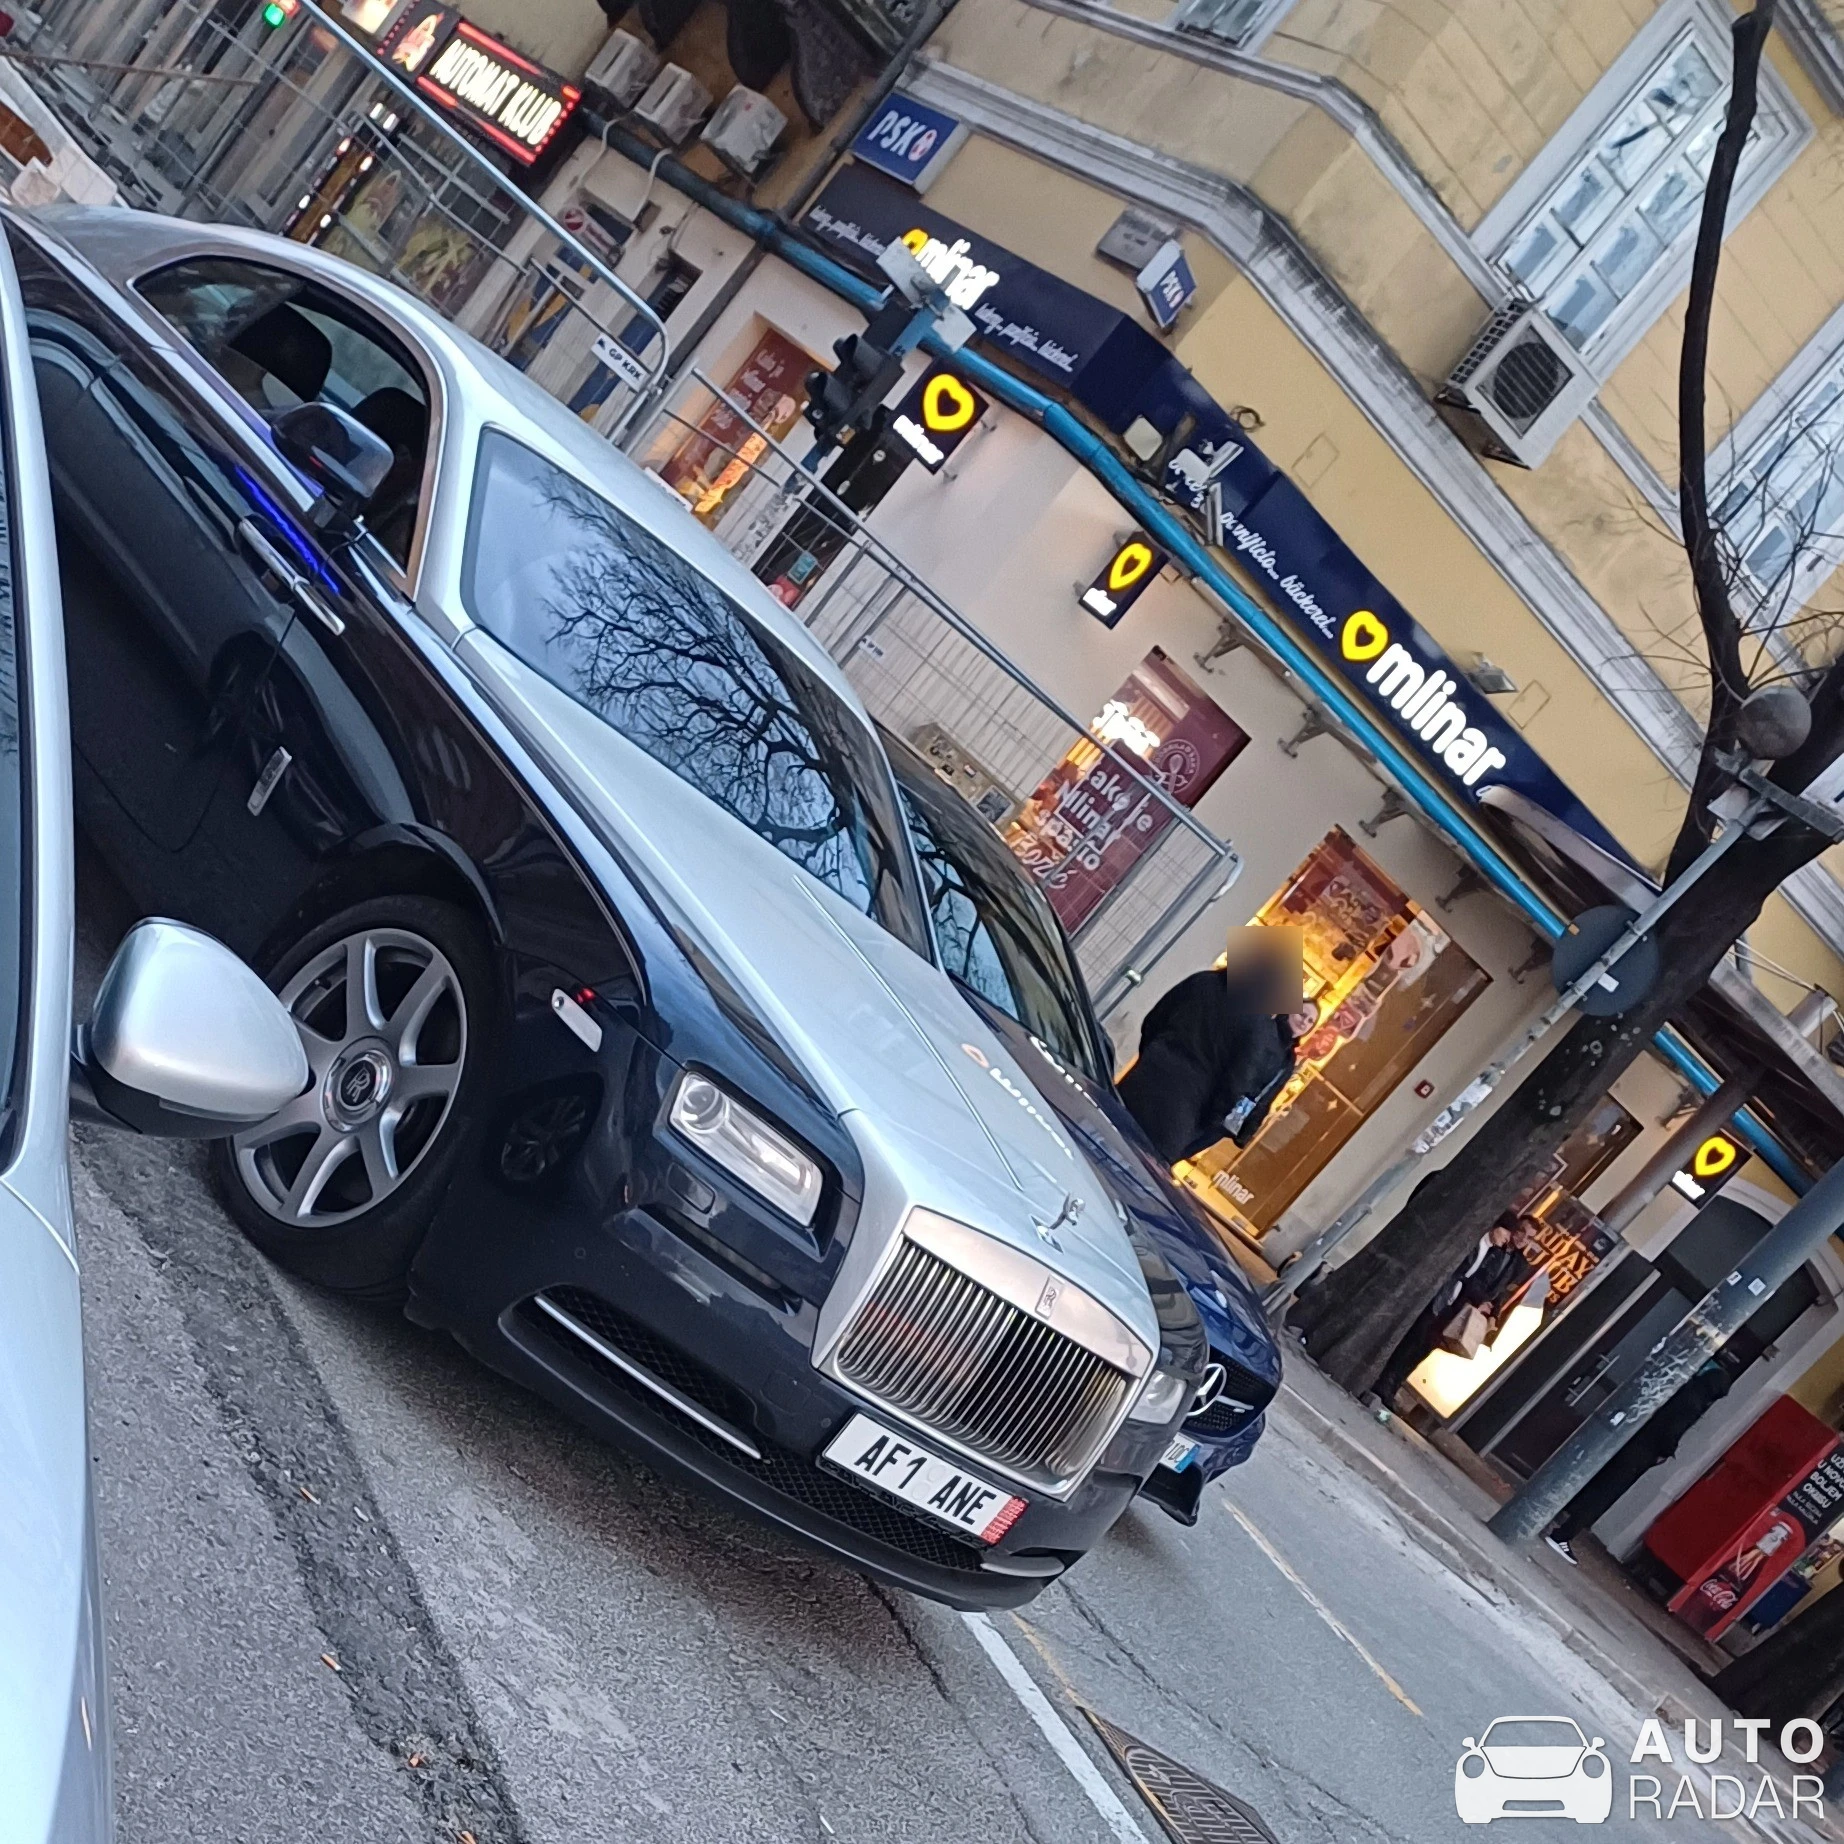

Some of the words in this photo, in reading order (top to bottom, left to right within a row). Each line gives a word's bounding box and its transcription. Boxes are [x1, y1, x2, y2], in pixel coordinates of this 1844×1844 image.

[429, 38, 521, 116] AUTOMAT
[497, 82, 562, 145] KLUB
[1366, 643, 1507, 785] mlinar
[1211, 1169, 1255, 1205] mlinar
[853, 1434, 928, 1490] AF1
[926, 1474, 998, 1526] ANE
[1809, 1471, 1843, 1502] BOLJEM
